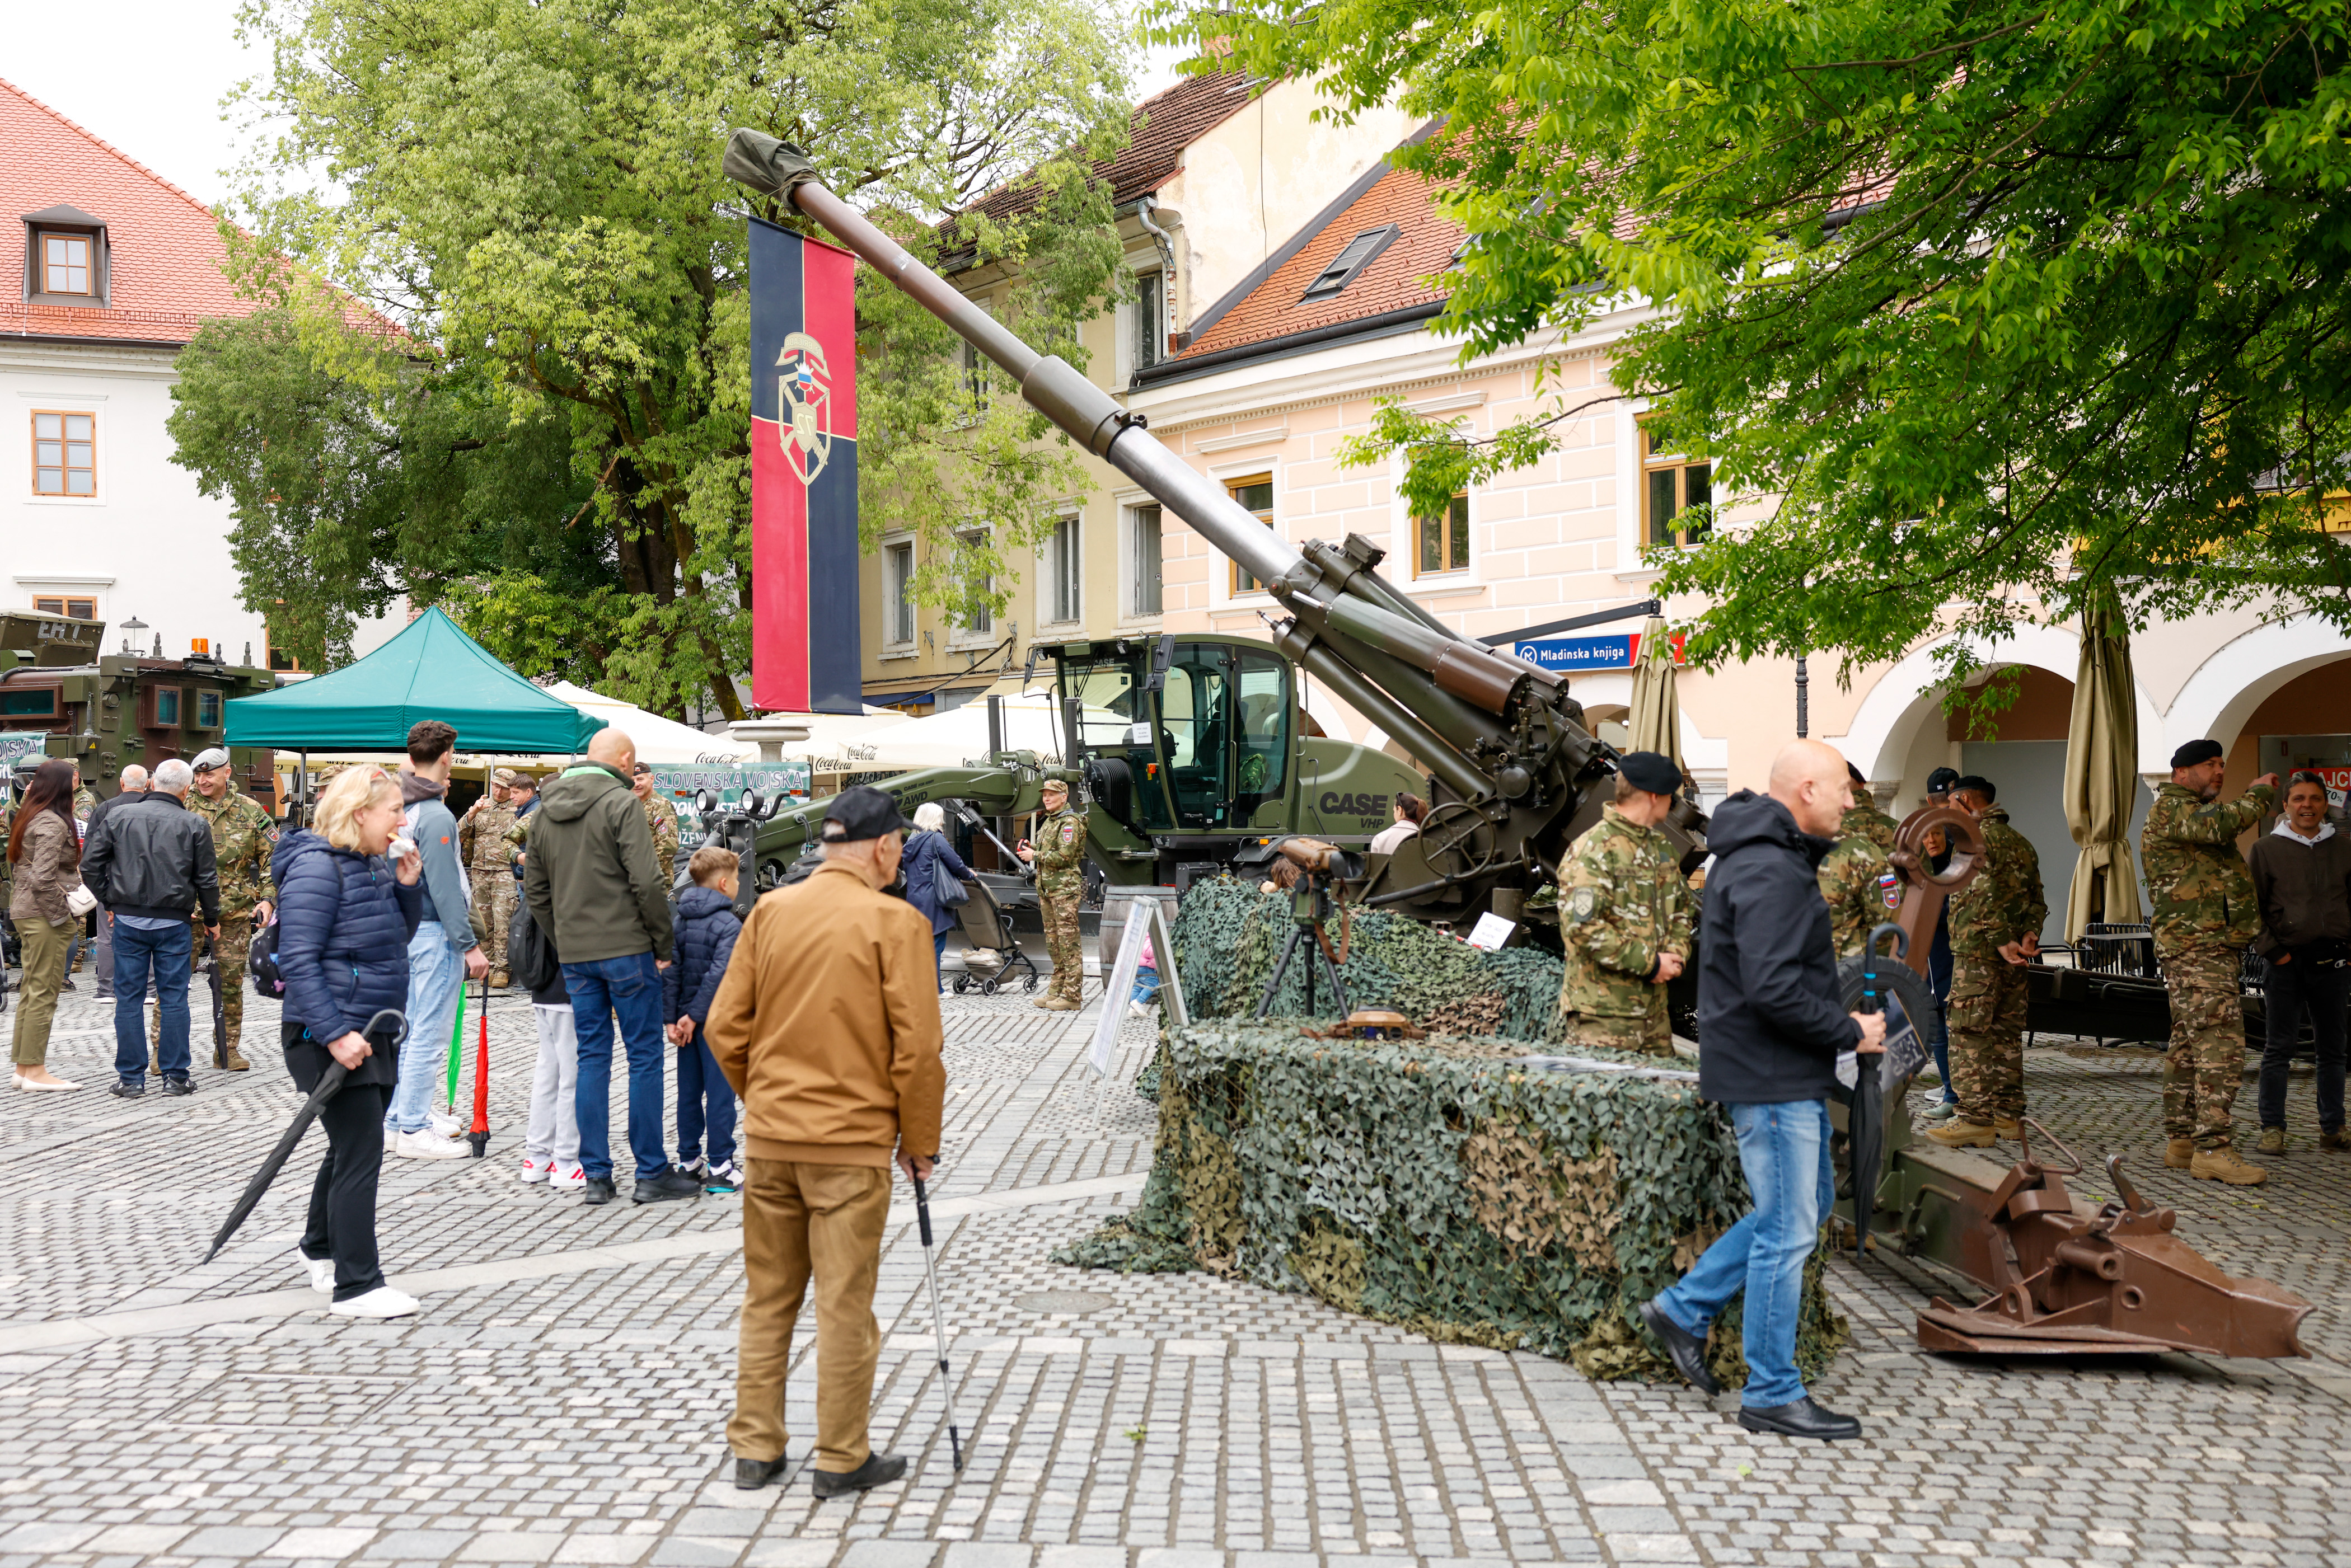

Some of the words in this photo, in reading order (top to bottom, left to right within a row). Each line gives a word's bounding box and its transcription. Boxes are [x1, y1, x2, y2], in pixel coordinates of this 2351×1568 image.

[1540, 647, 1590, 661] Mladinska
[1593, 646, 1624, 660] knjiga
[848, 743, 878, 760] Coca-Cola
[653, 771, 743, 789] SLOVENSKA
[746, 770, 804, 793] VOJSKA
[903, 791, 928, 806] AWD
[1319, 791, 1388, 816] CASE
[1361, 818, 1384, 829] VHP
